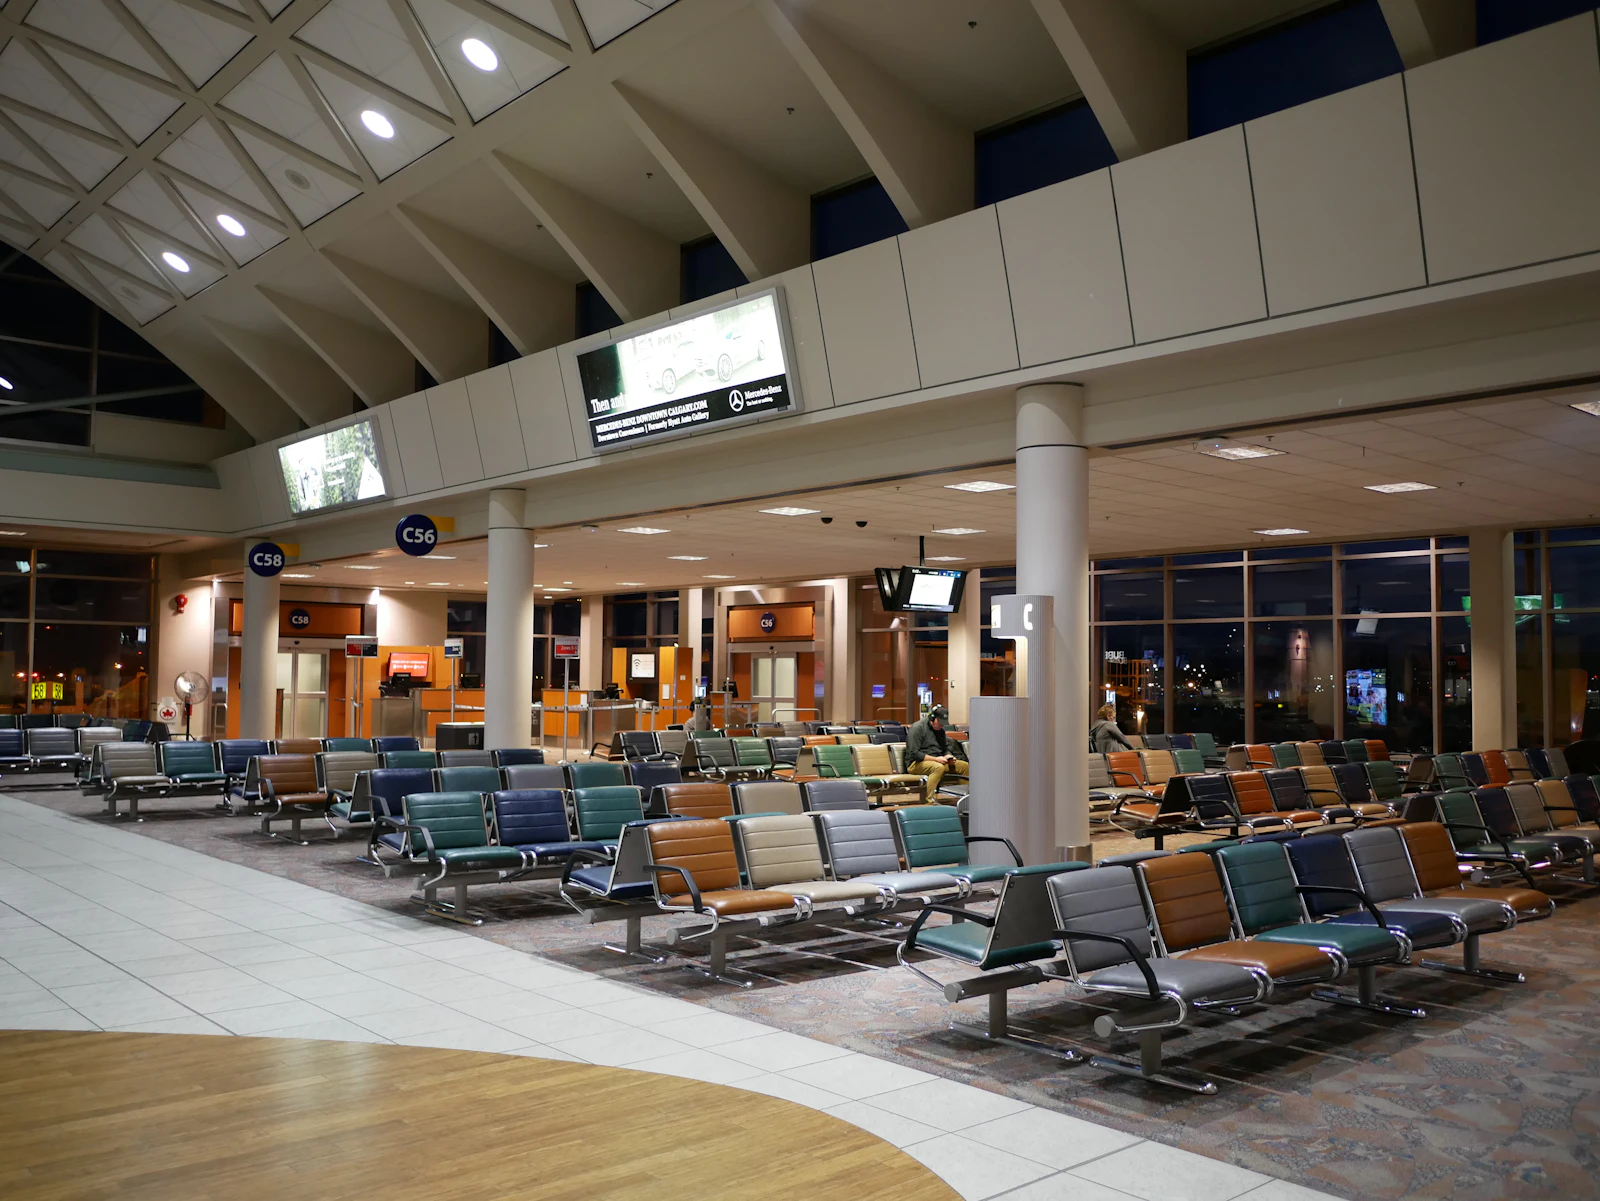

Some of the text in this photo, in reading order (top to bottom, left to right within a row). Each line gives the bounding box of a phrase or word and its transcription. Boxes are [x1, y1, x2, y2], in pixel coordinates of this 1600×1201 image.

[744, 385, 782, 400] Mercedes-Benz
[590, 392, 625, 413] Then and
[595, 400, 708, 434] MERCEDES-BENZ DOWNTOWN CALGARY.COM
[597, 431, 619, 443] Downtown
[618, 426, 645, 438] Convenience
[647, 420, 668, 431] Formerly
[681, 413, 692, 424] Auto
[691, 411, 710, 421] Gallery
[402, 527, 435, 544] C56
[253, 552, 283, 567] C58
[291, 615, 309, 625] C58
[760, 619, 773, 627] C56
[34, 684, 43, 698] 58
[55, 684, 62, 699] 58
